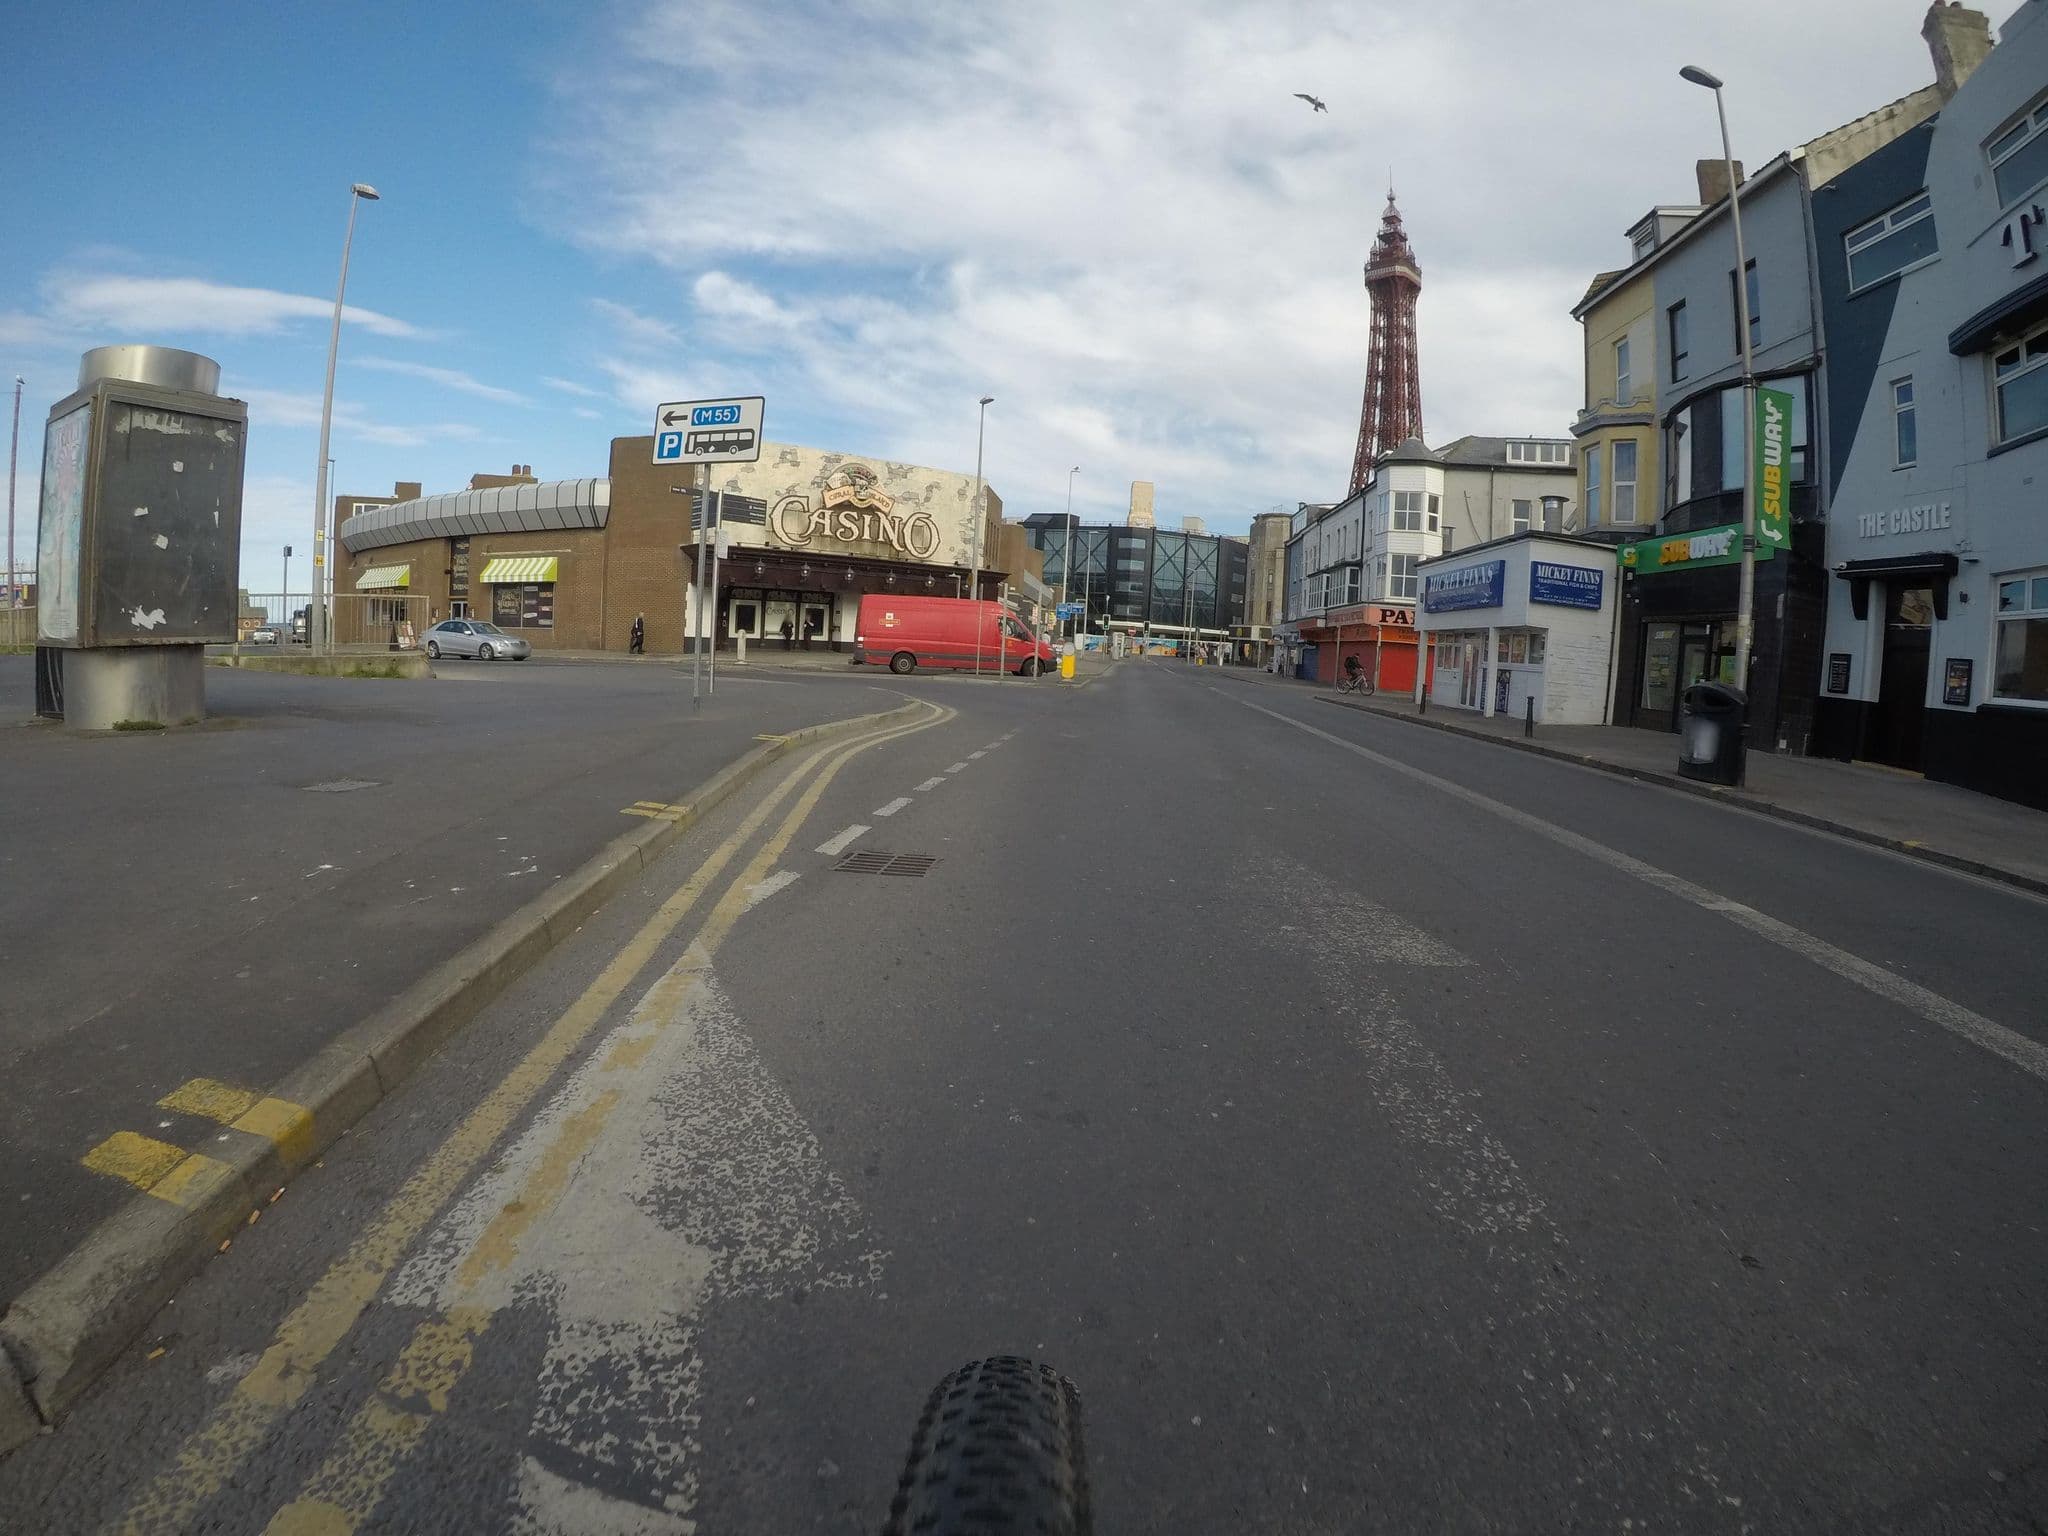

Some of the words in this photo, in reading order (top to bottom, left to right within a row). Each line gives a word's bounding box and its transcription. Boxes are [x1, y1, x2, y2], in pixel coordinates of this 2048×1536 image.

[663, 434, 679, 457] P
[1764, 397, 1782, 521] SUBWAY
[769, 495, 941, 559] CASINO
[1858, 512, 1886, 538] THE
[1889, 501, 1952, 535] CASTLE
[1659, 529, 1738, 566] SUBWAY
[1536, 564, 1572, 581] MICKEY
[1573, 569, 1601, 585] FINNS
[1379, 608, 1416, 625] PA
